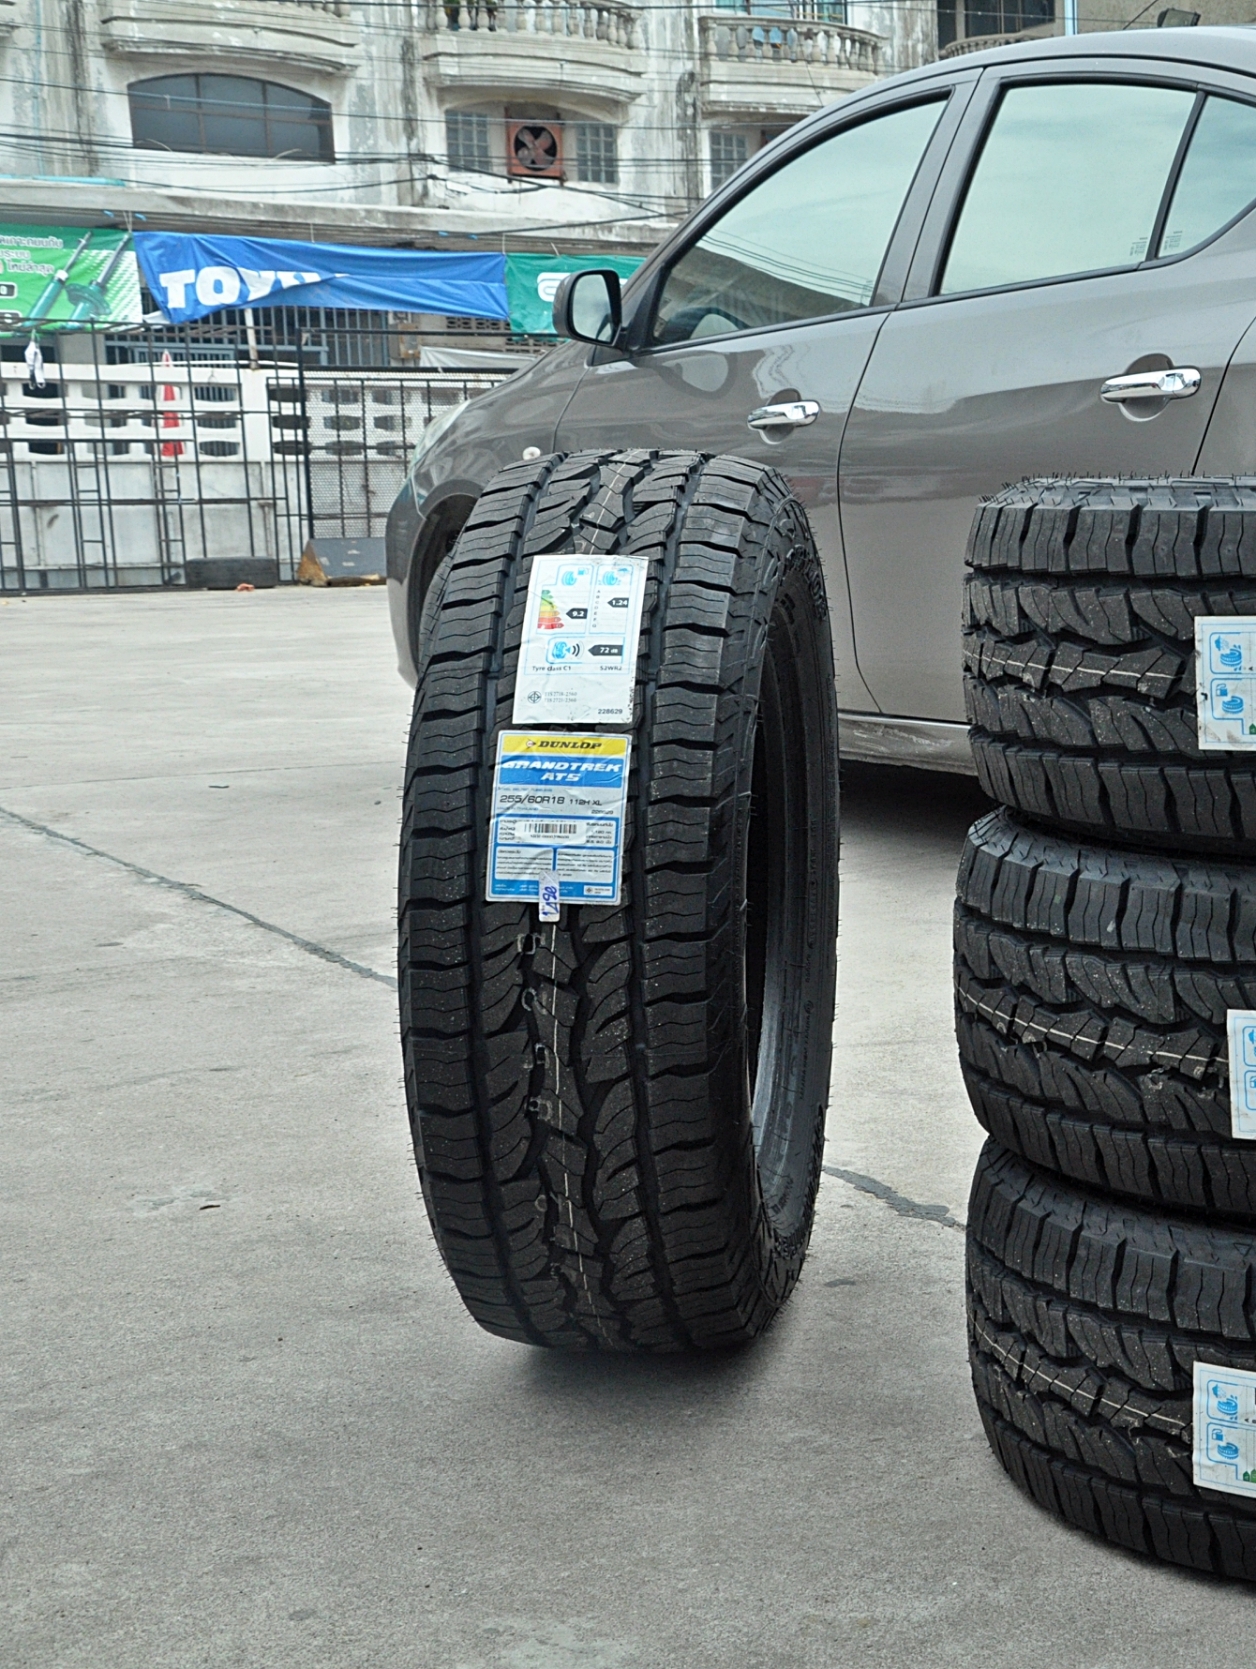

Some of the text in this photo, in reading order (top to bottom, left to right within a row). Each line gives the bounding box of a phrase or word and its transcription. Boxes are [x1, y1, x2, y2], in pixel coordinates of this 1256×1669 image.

[538, 740, 602, 750] DUNLOP
[501, 760, 622, 772] GRANDTREK
[500, 794, 565, 805] 255/60R18
[569, 798, 591, 806] 112H
